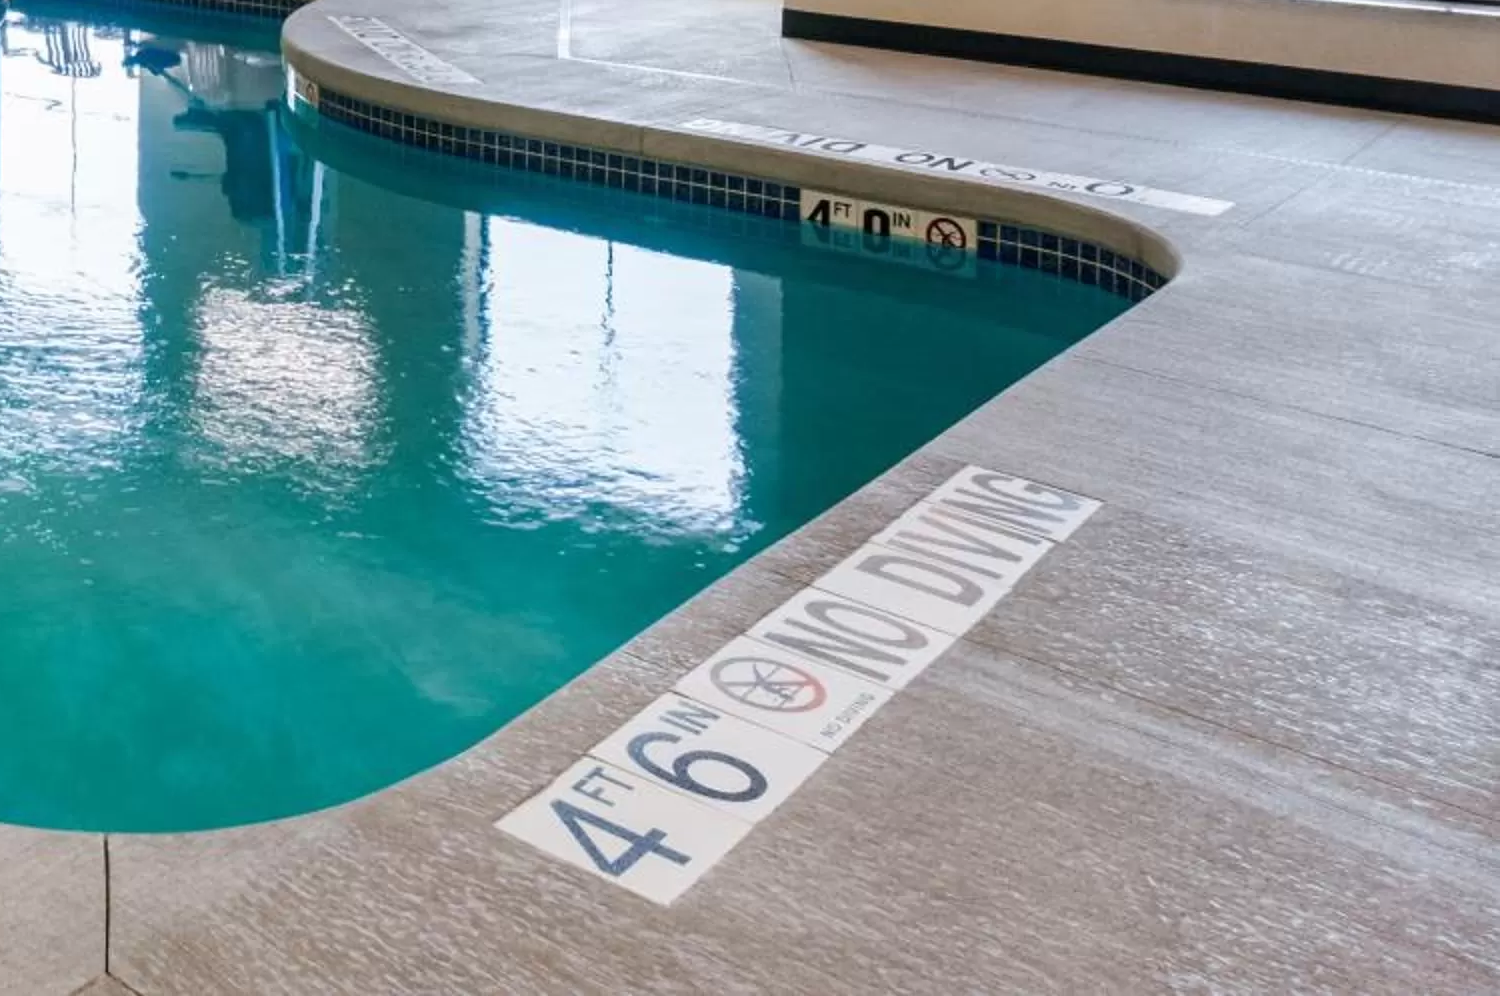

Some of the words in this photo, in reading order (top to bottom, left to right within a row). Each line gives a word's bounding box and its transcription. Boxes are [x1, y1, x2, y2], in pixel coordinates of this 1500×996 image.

[894, 151, 974, 171] NO
[764, 600, 929, 682] NO
[854, 472, 1081, 606] DIVING
